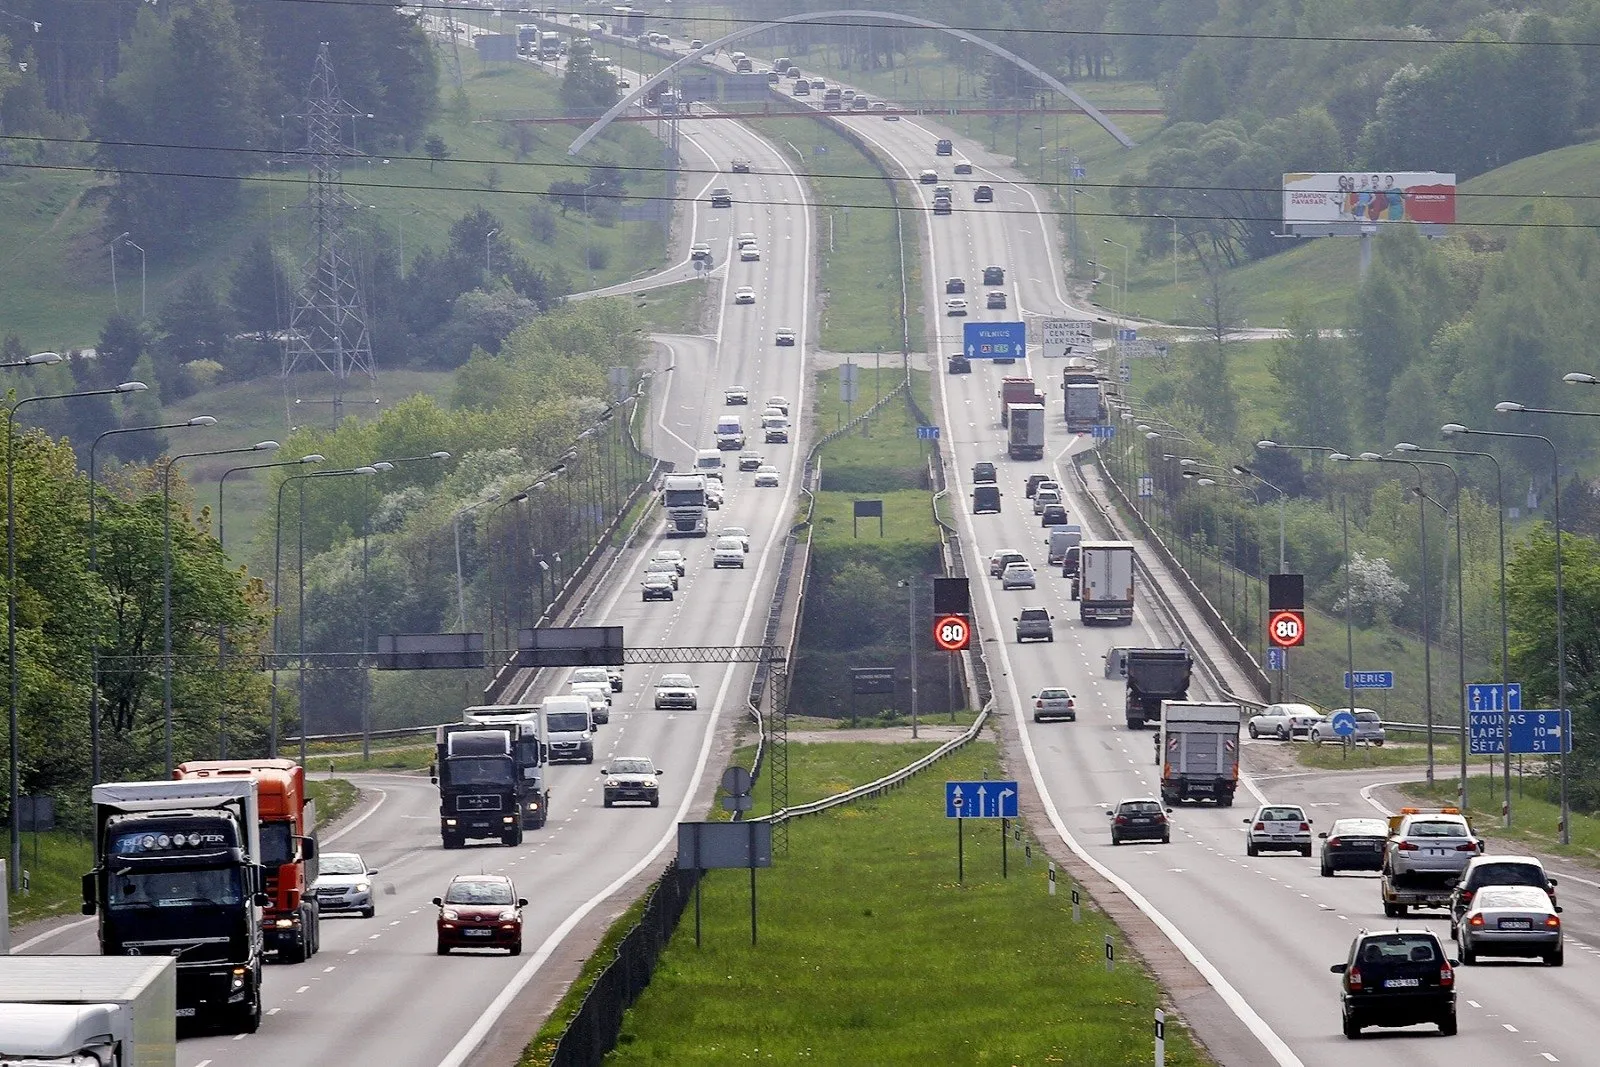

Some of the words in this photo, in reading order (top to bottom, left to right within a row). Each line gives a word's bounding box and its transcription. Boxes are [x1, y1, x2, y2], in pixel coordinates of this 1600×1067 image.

[1044, 322, 1092, 330] SENAMIESTIS
[979, 330, 1010, 338] VILNIUS
[941, 625, 963, 641] 80
[1276, 621, 1298, 637] 80
[1352, 674, 1386, 683] NERIS
[1538, 714, 1546, 724] 8
[1533, 727, 1546, 737] 10
[1533, 740, 1546, 750] 51
